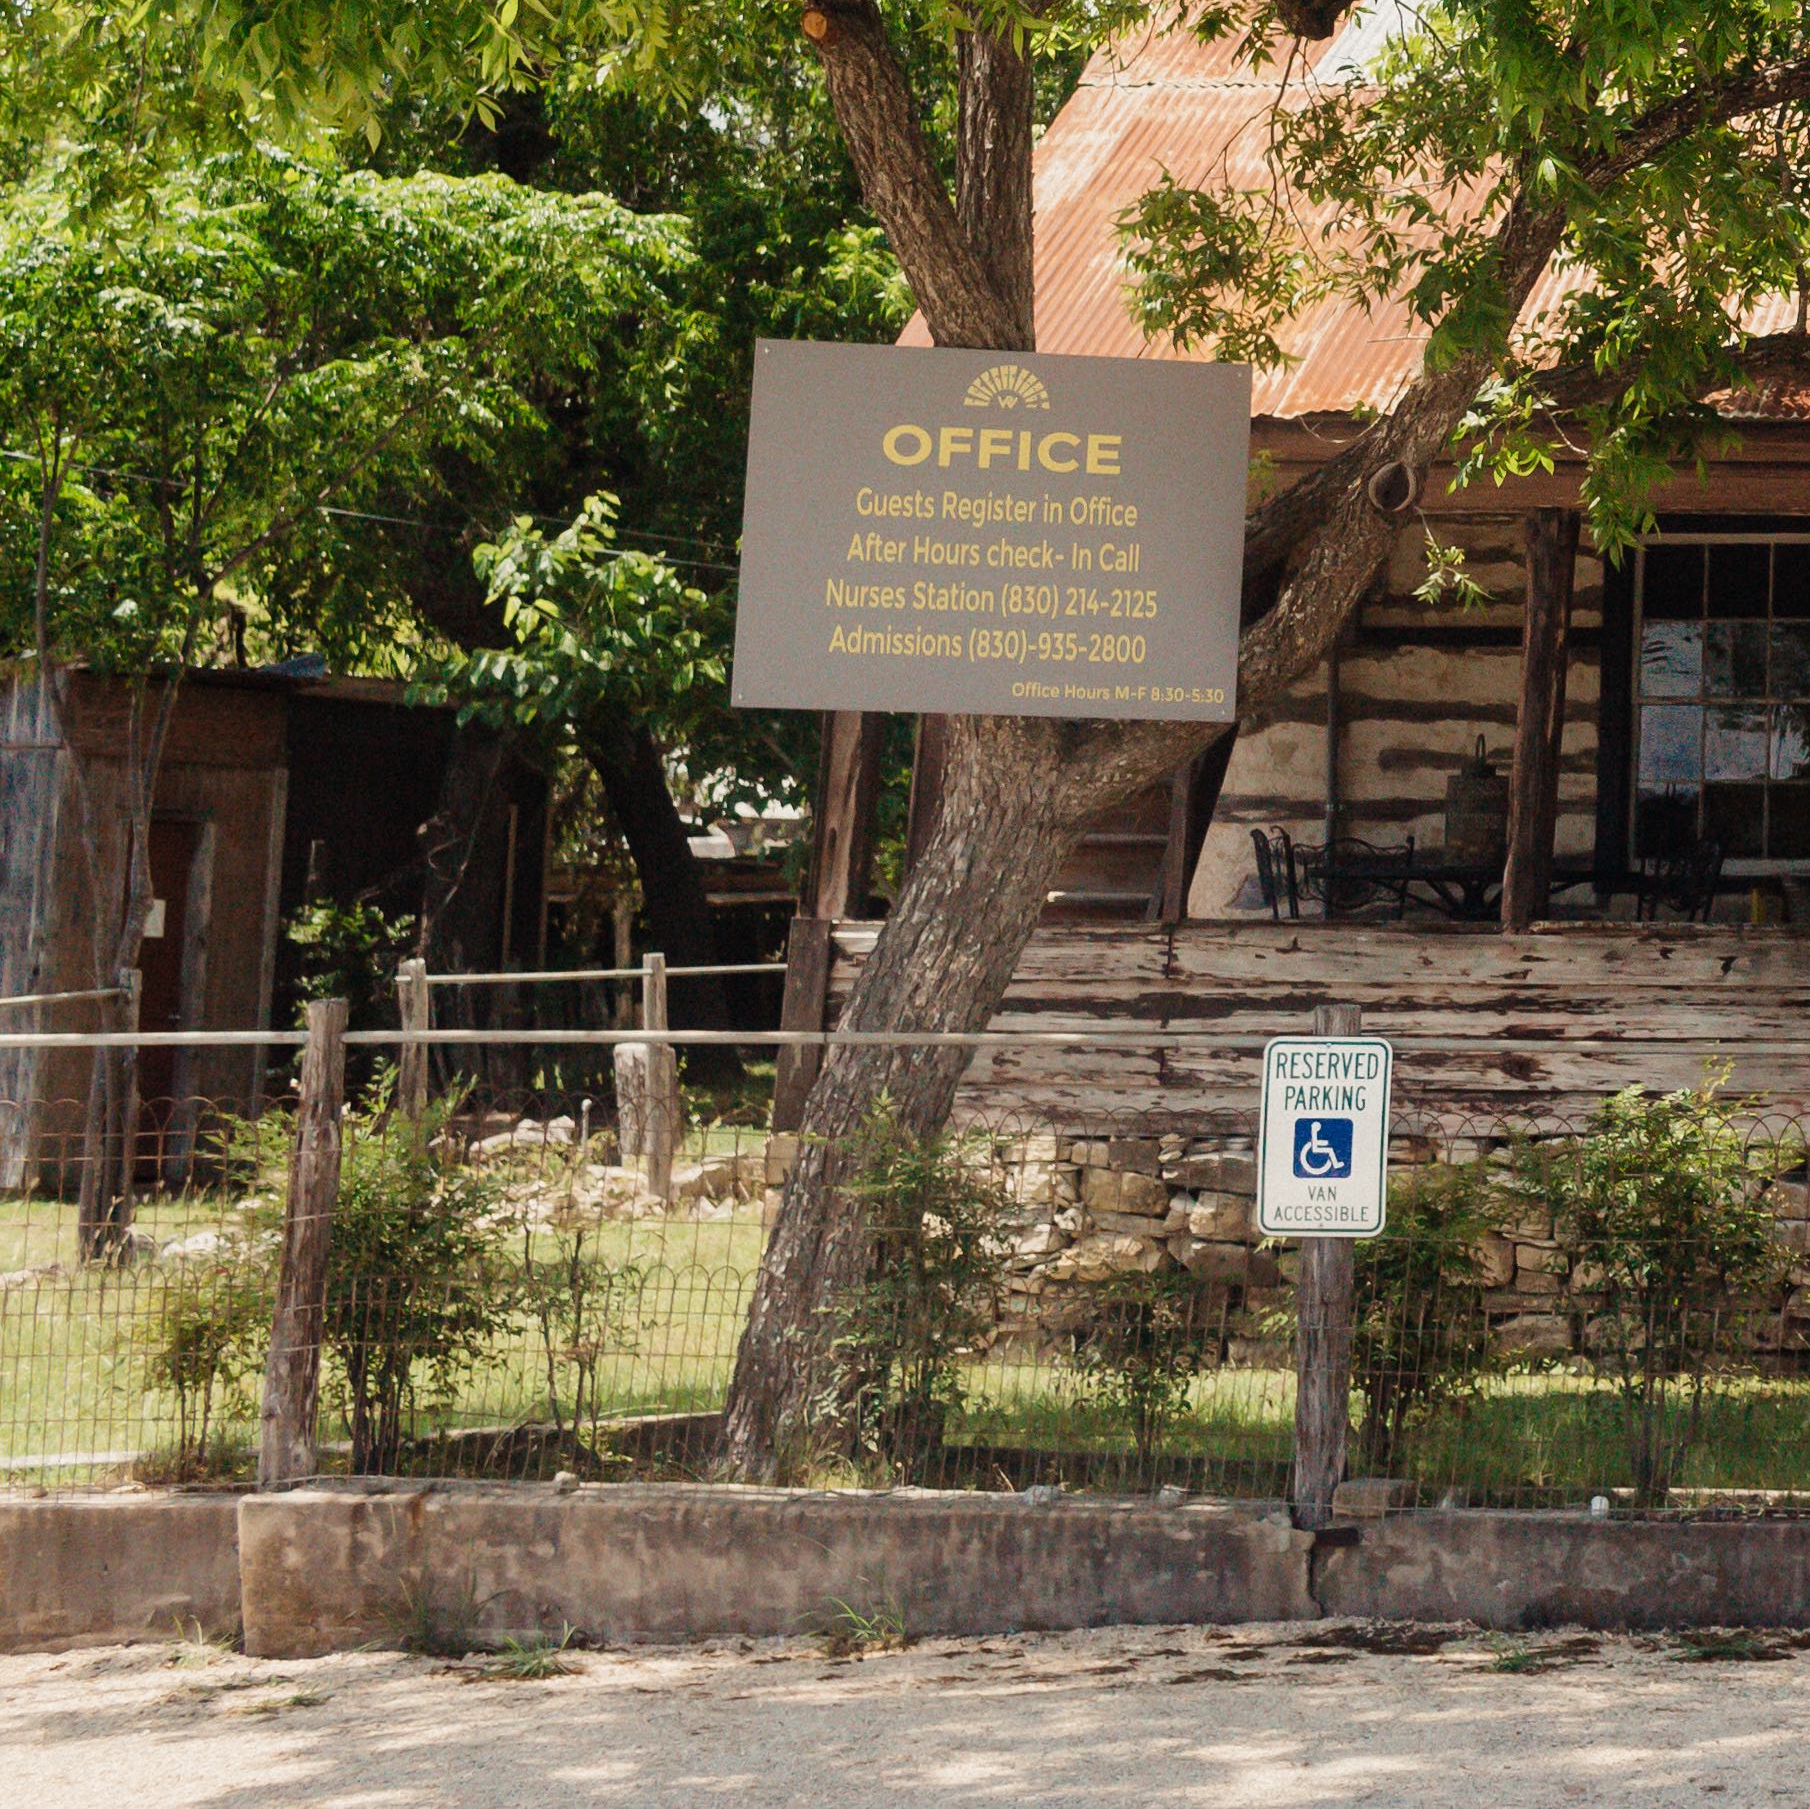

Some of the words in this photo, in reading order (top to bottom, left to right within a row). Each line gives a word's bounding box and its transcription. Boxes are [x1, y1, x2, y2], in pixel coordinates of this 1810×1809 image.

[882, 424, 1123, 475] OFFICE
[856, 487, 934, 518] Guests
[942, 491, 1036, 527] Register
[1043, 493, 1064, 523] in
[1069, 496, 1137, 527] Office
[848, 532, 906, 563] After
[914, 537, 980, 566] Hours
[1072, 544, 1092, 570] In
[1099, 543, 1140, 572] Call
[827, 579, 904, 608] Nurses
[913, 580, 994, 611] Station
[1001, 583, 1059, 619] (830)
[1065, 587, 1156, 618] 214-2125
[829, 626, 961, 657] Admissions
[969, 629, 1145, 663] (830)-935-2800
[1011, 682, 1060, 698] Office
[1064, 684, 1110, 701] Hours
[1115, 685, 1146, 701] M-F
[1151, 687, 1224, 704] 8:30-5:30
[1276, 1052, 1379, 1080] RESERVED
[1285, 1085, 1366, 1111] PARKING
[1308, 1186, 1336, 1201] VAN
[1274, 1206, 1369, 1222] ACCESSIBLE
